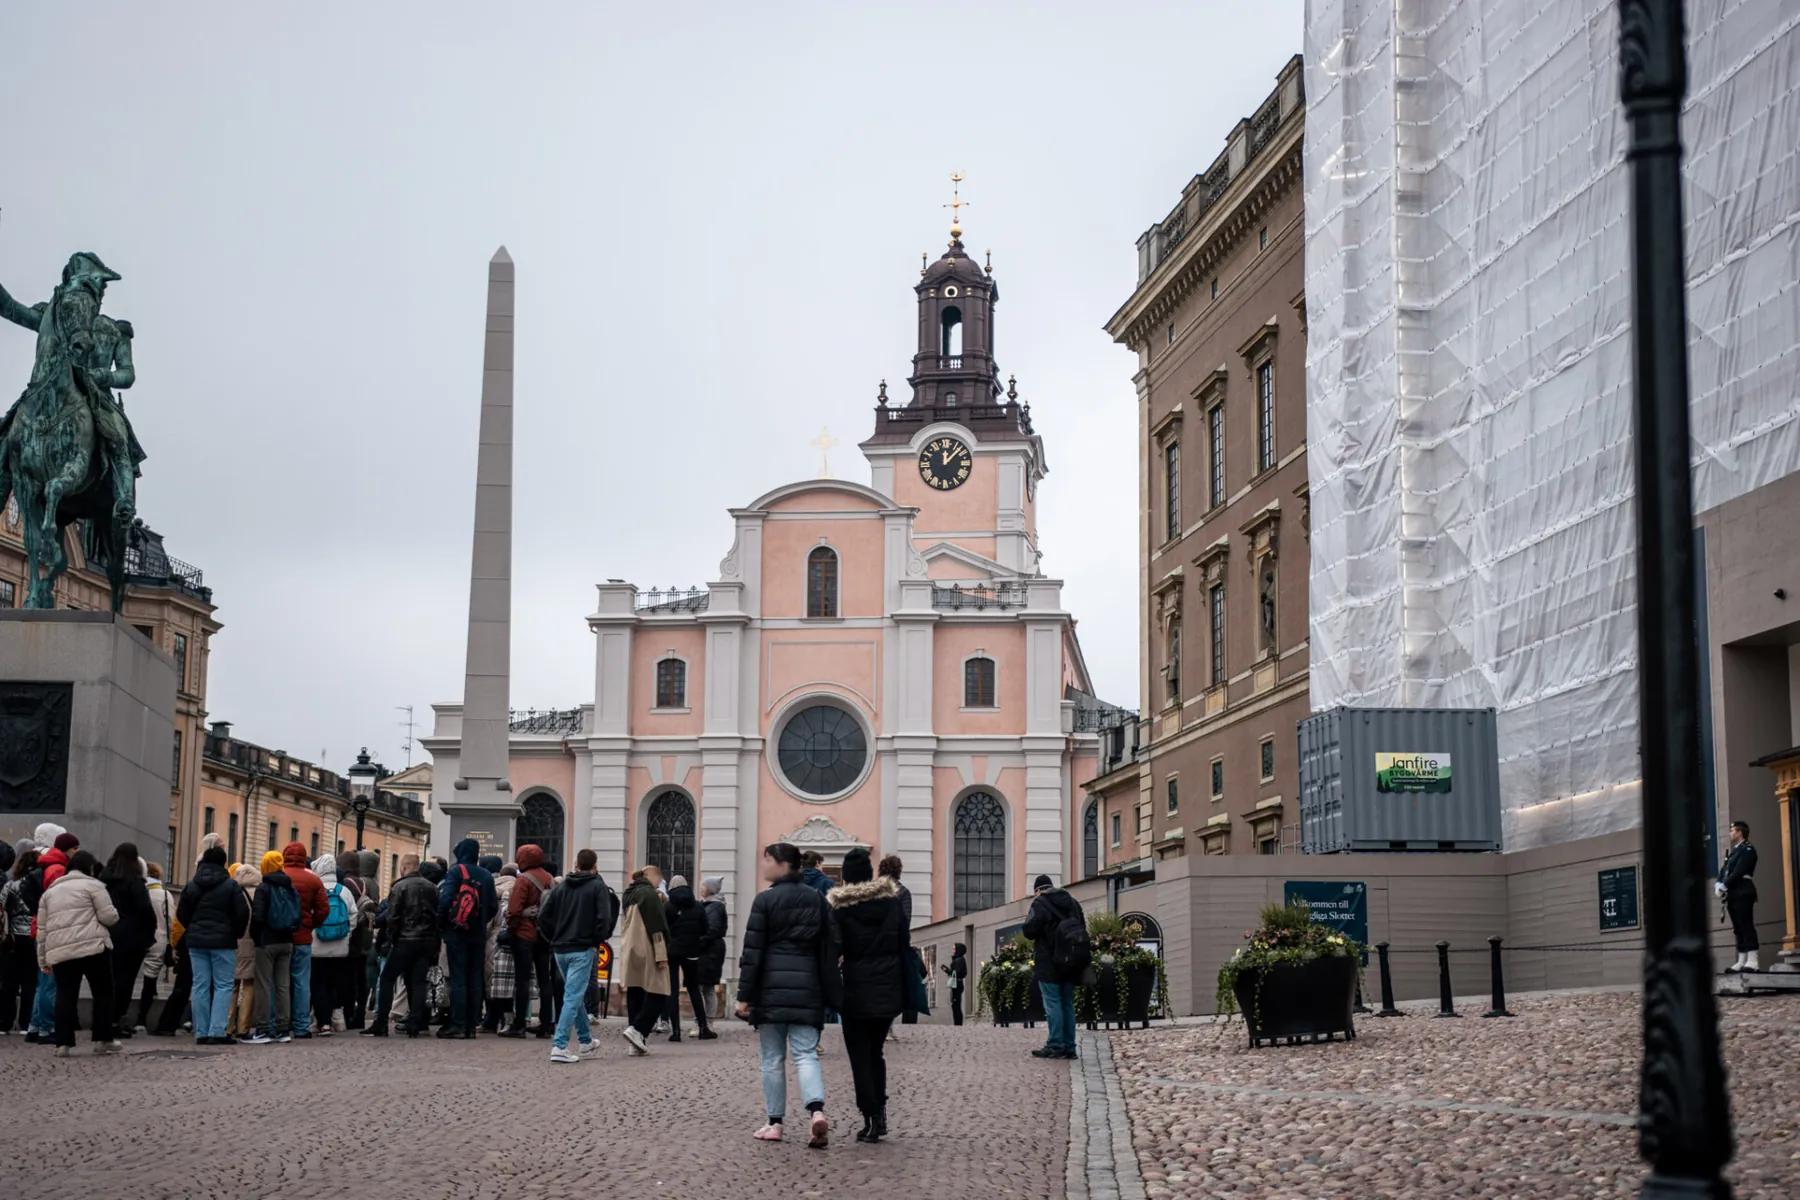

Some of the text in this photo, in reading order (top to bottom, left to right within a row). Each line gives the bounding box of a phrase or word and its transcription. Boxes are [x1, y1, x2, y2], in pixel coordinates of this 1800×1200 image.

[1390, 756, 1438, 769] Janfire
[1292, 899, 1349, 909] Vlkommen till
[1329, 911, 1356, 920] Slottet
